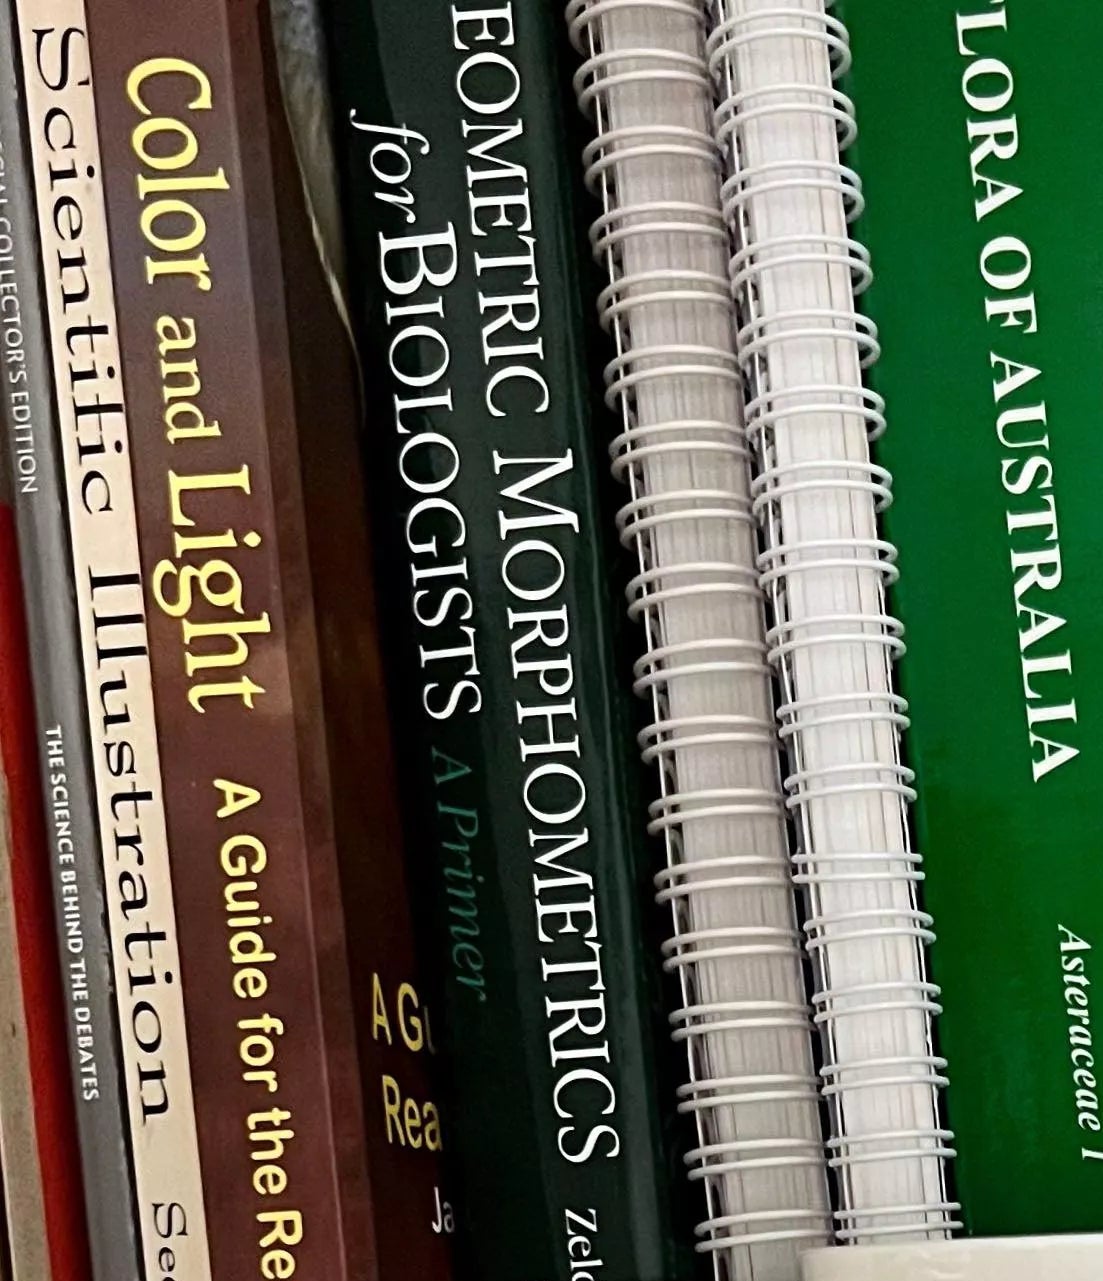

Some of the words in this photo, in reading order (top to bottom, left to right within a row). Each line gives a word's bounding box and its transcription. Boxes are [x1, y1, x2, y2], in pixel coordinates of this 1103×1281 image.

[954, 0, 1025, 224] LORA
[125, 56, 230, 292] Color
[350, 108, 430, 224] for
[450, 0, 550, 419] EOMETRIC
[979, 234, 1038, 336] OF
[154, 313, 221, 445] and
[12, 391, 39, 493] EDITION
[378, 221, 483, 720] BIOLOGISTS
[31, 26, 126, 516] Scientific
[87, 565, 175, 1126] Illustration
[151, 463, 272, 714] Light
[990, 350, 1081, 783] AUSTRALIA
[45, 724, 66, 769] THE
[431, 745, 473, 785] A
[50, 772, 76, 865] SCIENCE
[212, 777, 262, 819] A
[492, 447, 621, 1164] MORPHOMETRICS
[60, 870, 85, 962] BEHIND
[218, 833, 277, 999] Guide
[436, 802, 487, 1003] Primer
[68, 961, 89, 1002] THE
[372, 972, 393, 1046] A
[1057, 923, 1102, 1132] Asteraceae
[75, 1005, 100, 1101] DEBATES
[237, 1012, 285, 1094] for
[246, 1107, 295, 1196] the
[381, 1074, 443, 1152] Rea
[431, 1186, 455, 1234] Ja
